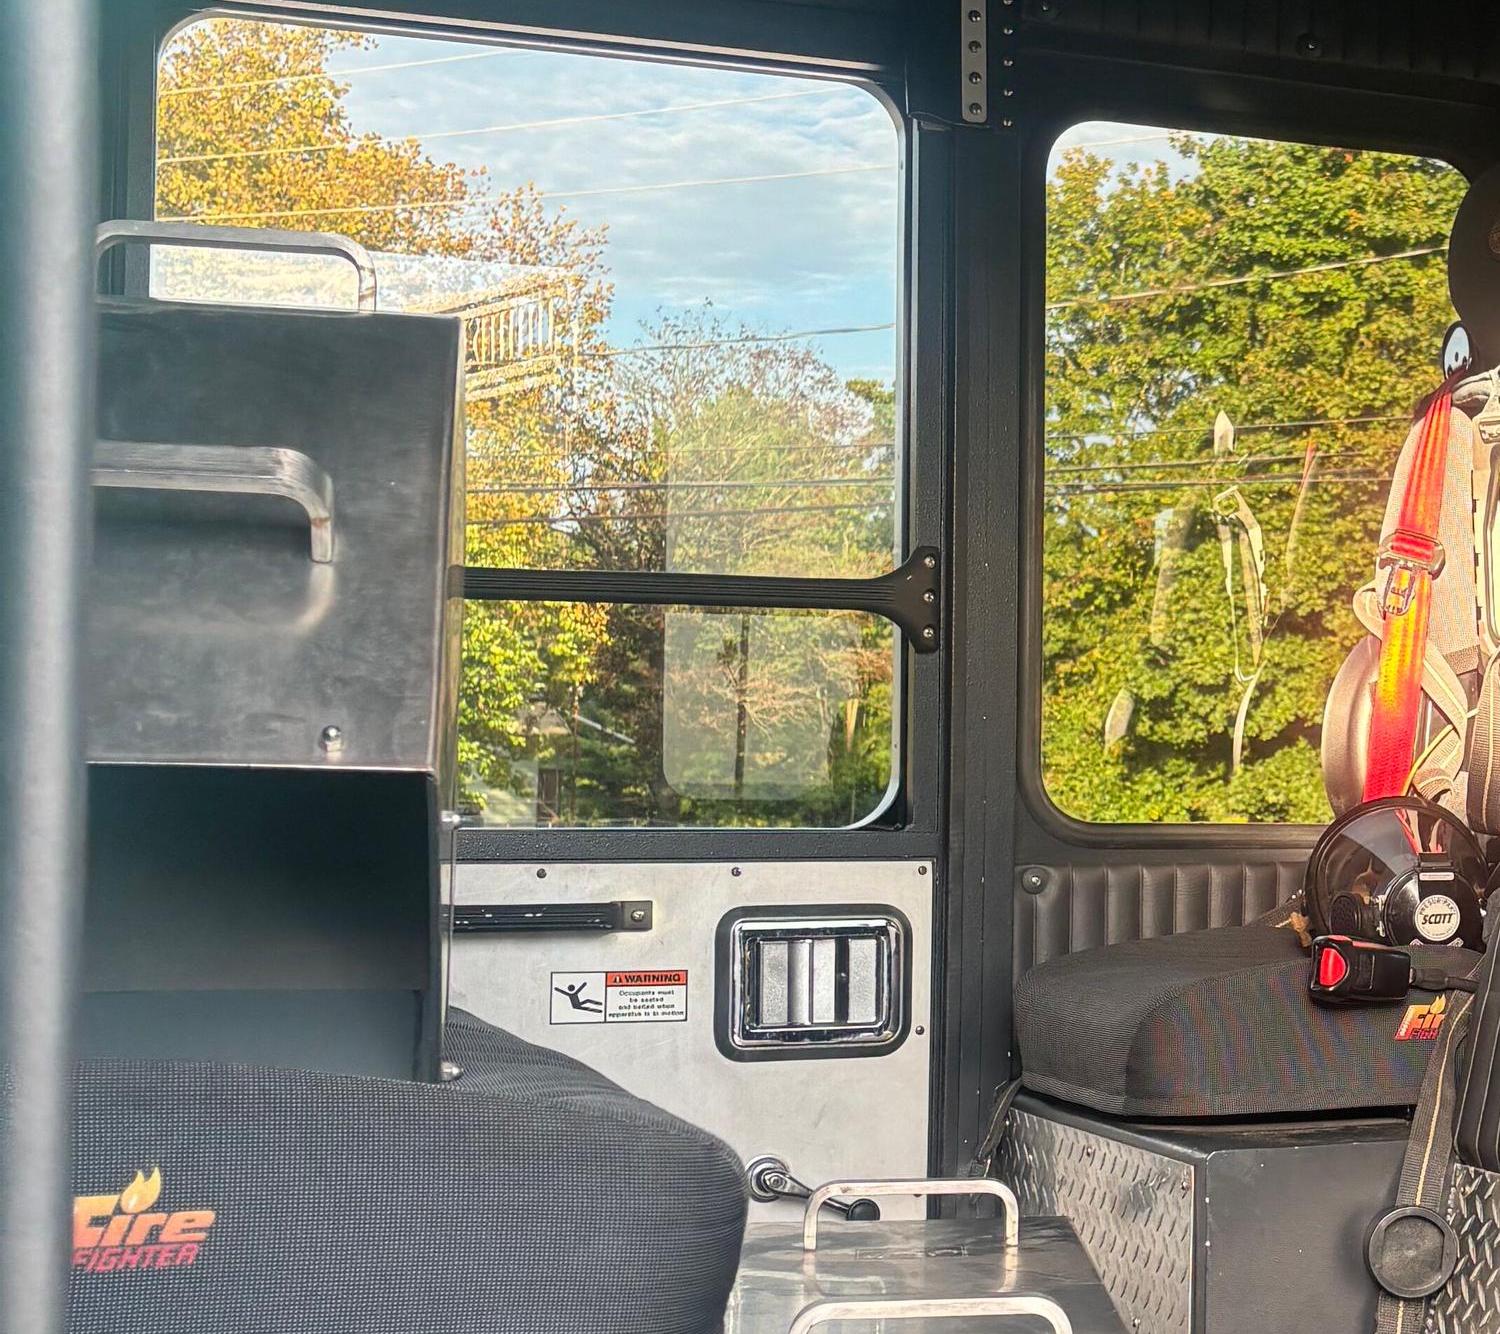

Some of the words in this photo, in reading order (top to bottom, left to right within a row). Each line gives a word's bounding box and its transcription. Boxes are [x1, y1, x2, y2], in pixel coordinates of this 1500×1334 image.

[1421, 913, 1453, 925] SCOTT
[624, 973, 681, 983] WARNING
[1395, 994, 1446, 1041] Fir
[73, 1167, 216, 1248] Fire
[73, 1243, 200, 1273] FIGHTER
